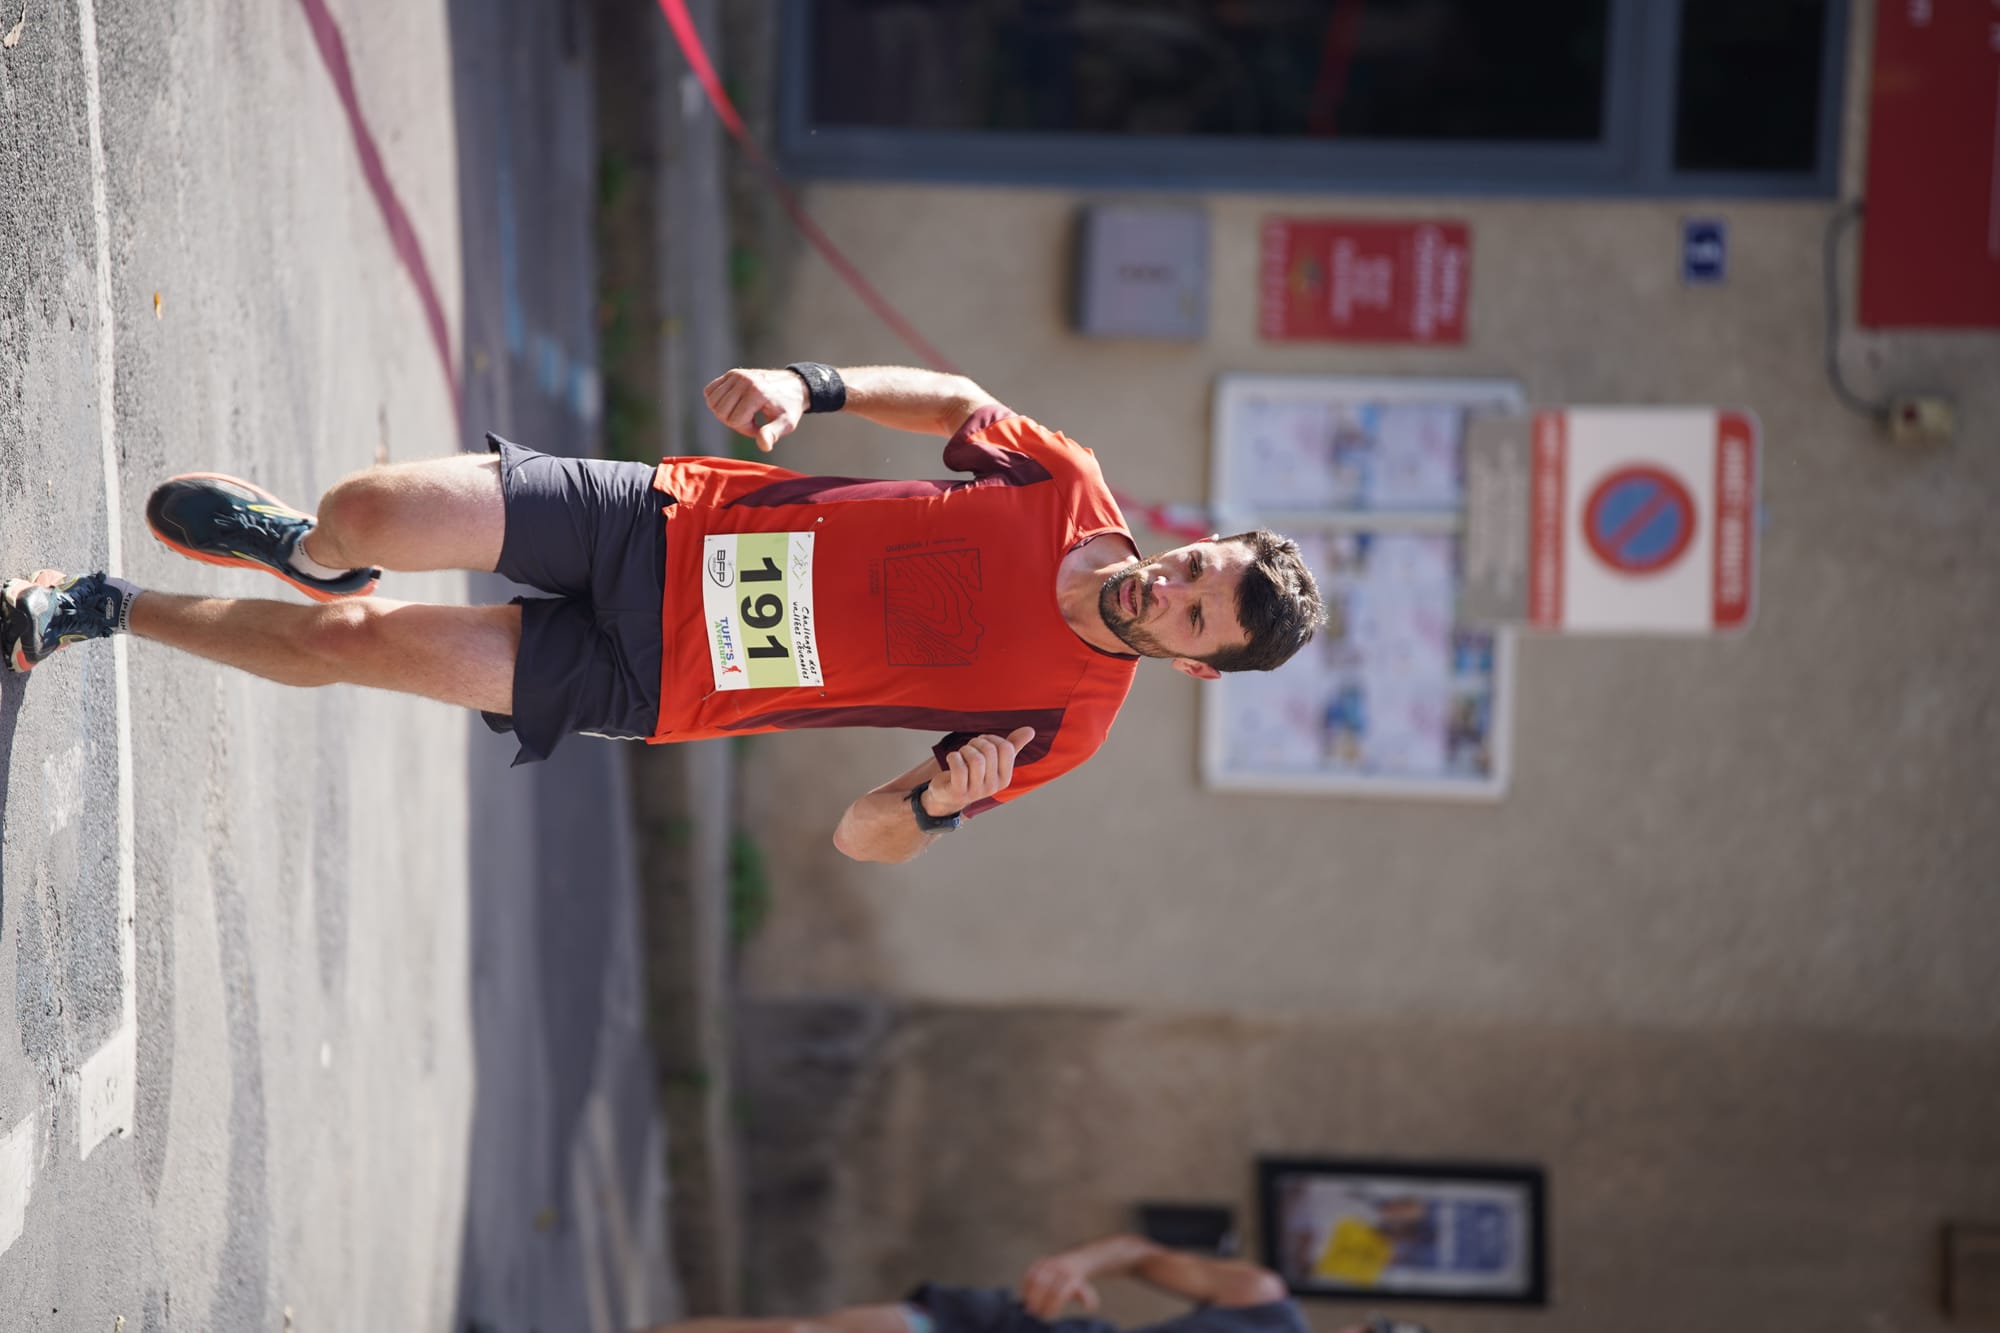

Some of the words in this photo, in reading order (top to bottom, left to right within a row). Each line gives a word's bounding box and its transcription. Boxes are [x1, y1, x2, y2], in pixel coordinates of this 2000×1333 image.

[717, 549, 726, 582] BFP
[120, 592, 133, 631] KIPRUN
[739, 557, 789, 659] 191
[792, 601, 802, 635] vallées
[714, 620, 728, 665] Aventure
[720, 617, 735, 661] TUFF'S
[801, 606, 813, 654] Challenge
[808, 660, 817, 675] des
[796, 641, 810, 680] cévenoles
